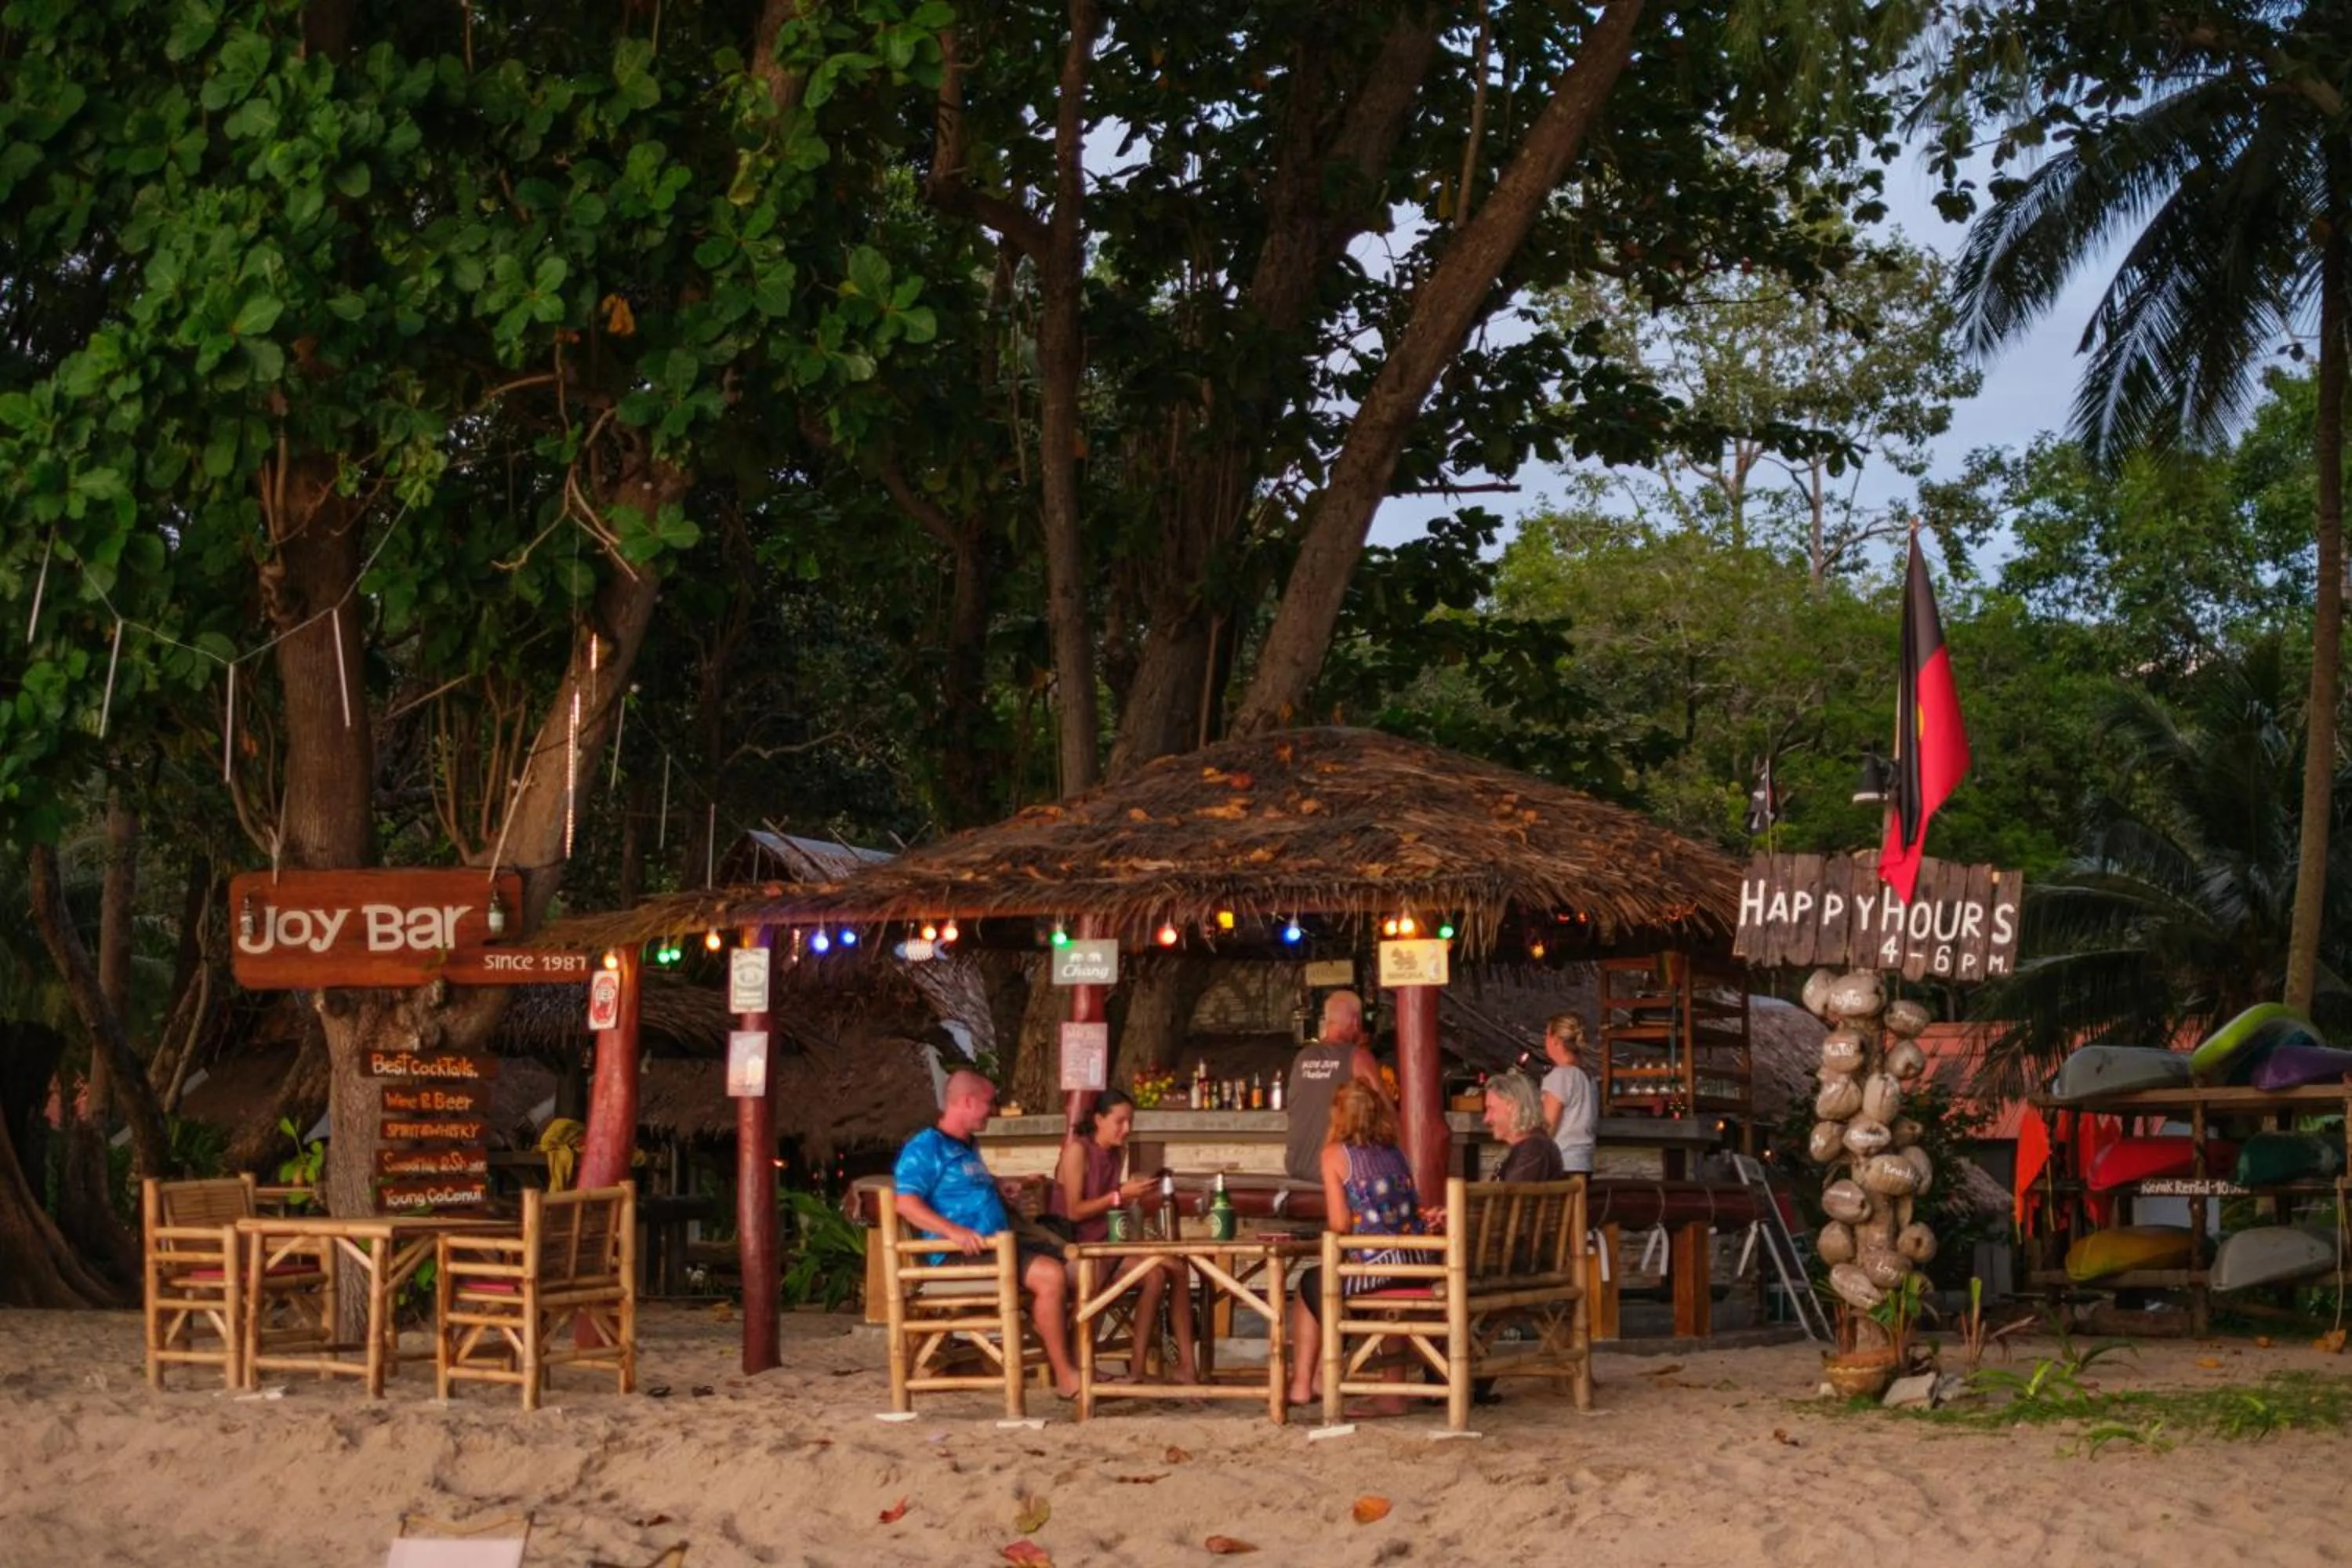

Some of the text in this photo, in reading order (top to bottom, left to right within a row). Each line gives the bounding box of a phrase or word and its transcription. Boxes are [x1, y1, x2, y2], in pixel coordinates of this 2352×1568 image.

[1739, 878, 2016, 944] HAPPY HOURS
[238, 904, 474, 954] Joy Bar
[542, 955, 586, 971] 1987
[1062, 964, 1109, 979] Chang
[434, 1091, 474, 1111] Beer
[382, 1189, 426, 1207] Young
